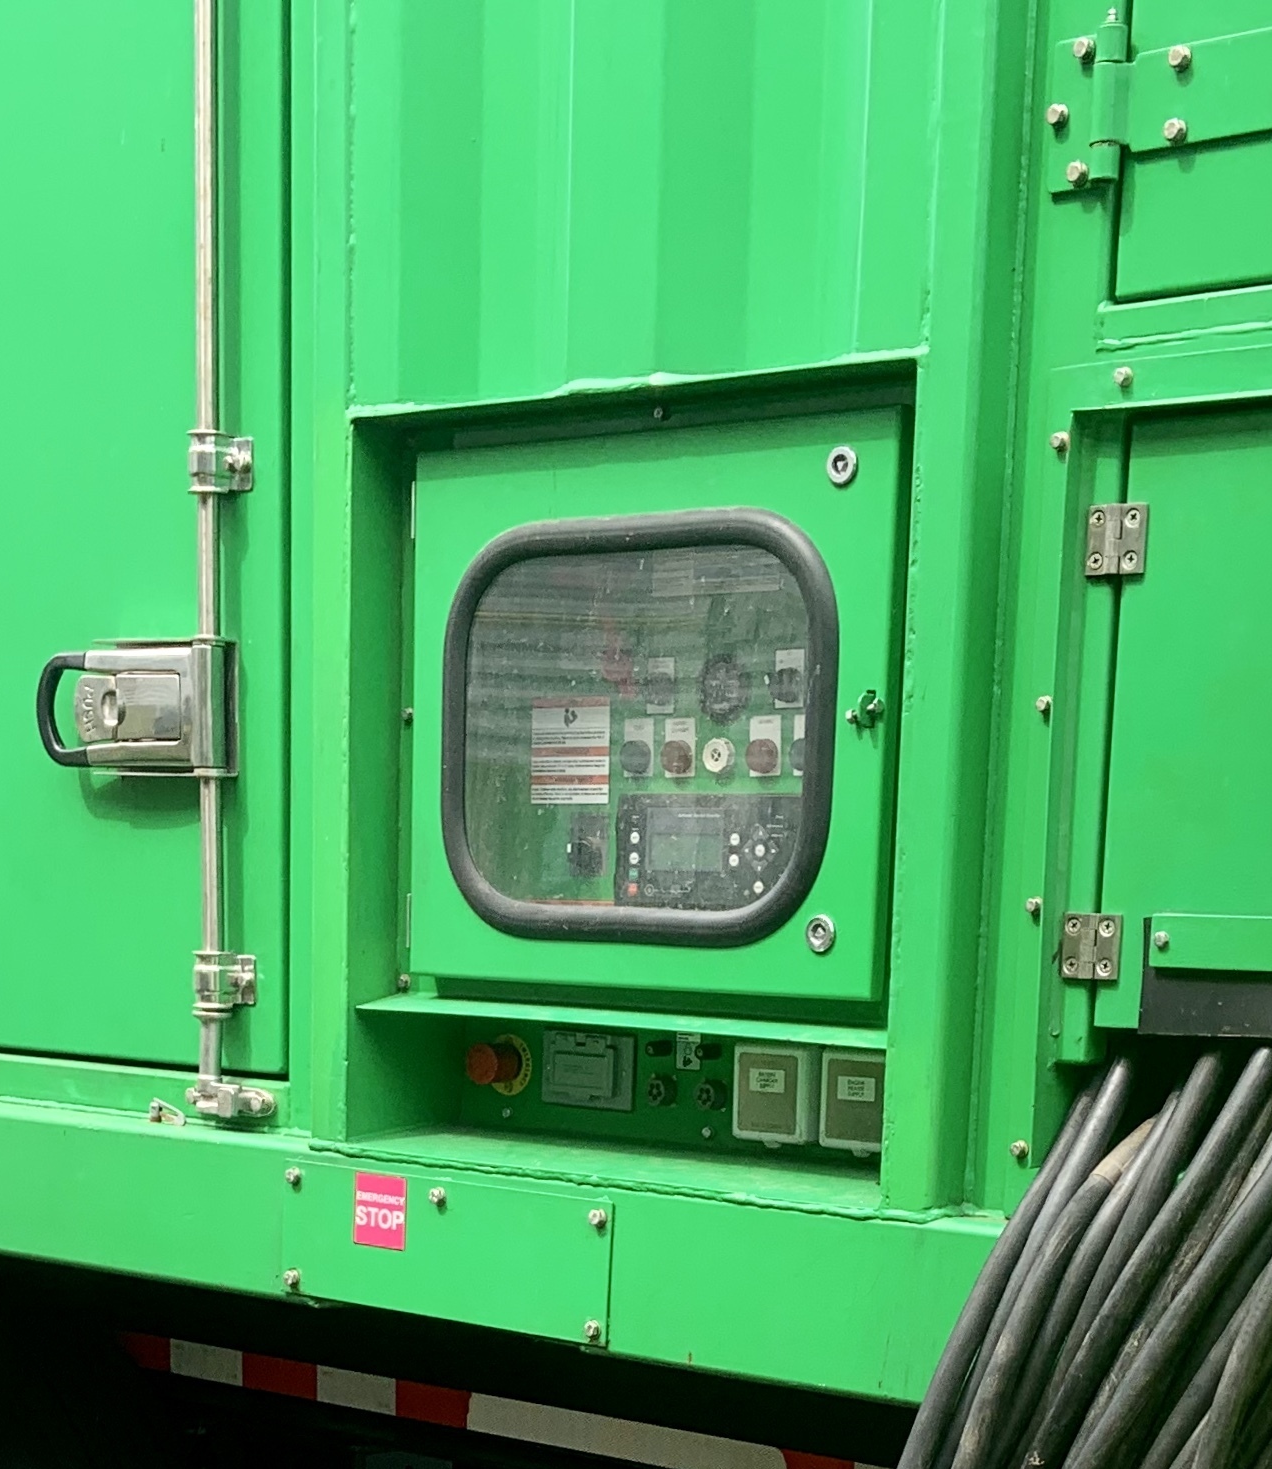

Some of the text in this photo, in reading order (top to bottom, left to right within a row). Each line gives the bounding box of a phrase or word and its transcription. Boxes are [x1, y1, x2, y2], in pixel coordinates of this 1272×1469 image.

[82, 685, 96, 735] PUSH
[356, 1190, 405, 1206] EMERGENCY
[355, 1205, 405, 1230] STOP
